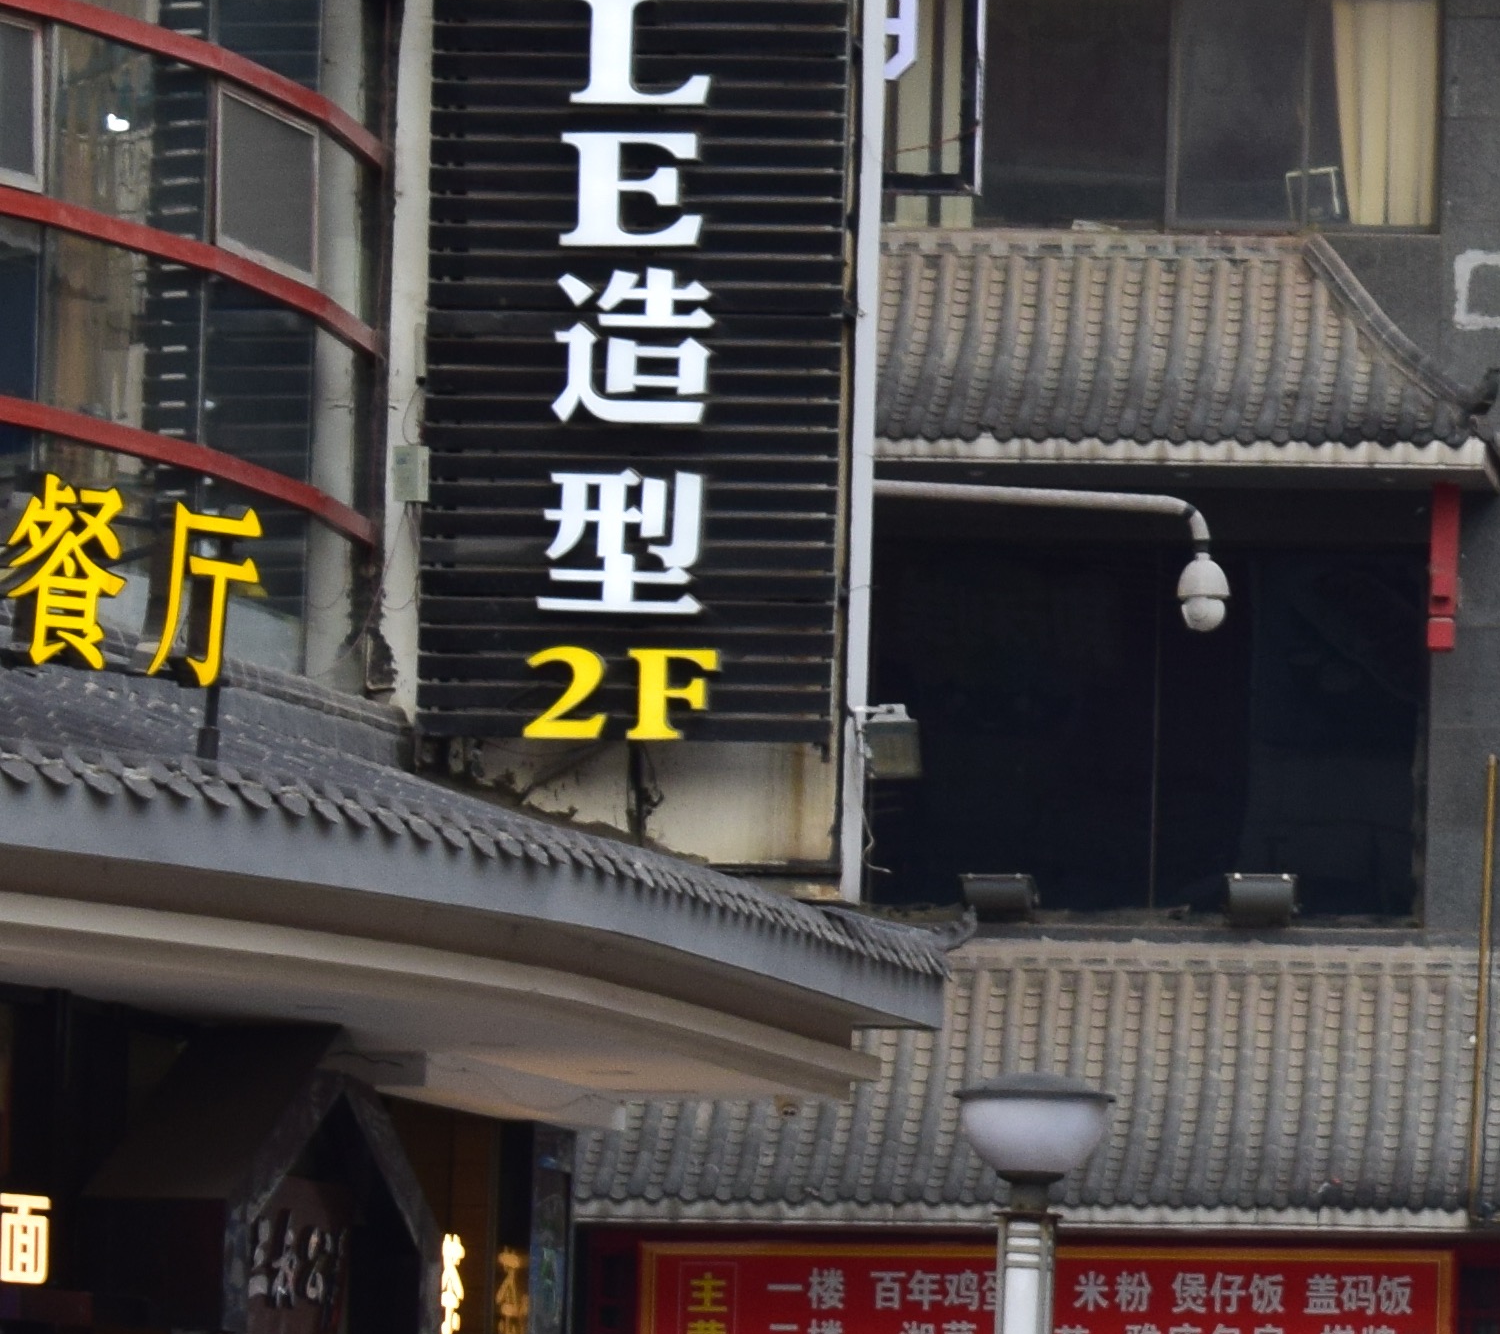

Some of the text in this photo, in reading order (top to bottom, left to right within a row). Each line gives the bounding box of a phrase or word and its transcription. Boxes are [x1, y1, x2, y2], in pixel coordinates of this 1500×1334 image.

[536, 267, 716, 616] 造型
[5, 473, 262, 687] 餐厅
[522, 645, 721, 741] 2F
[767, 1267, 846, 1310] 一楼
[1073, 1271, 1153, 1313] 米粉
[1171, 1272, 1286, 1315] 煲仔饭
[1303, 1274, 1414, 1317] 盖码饭
